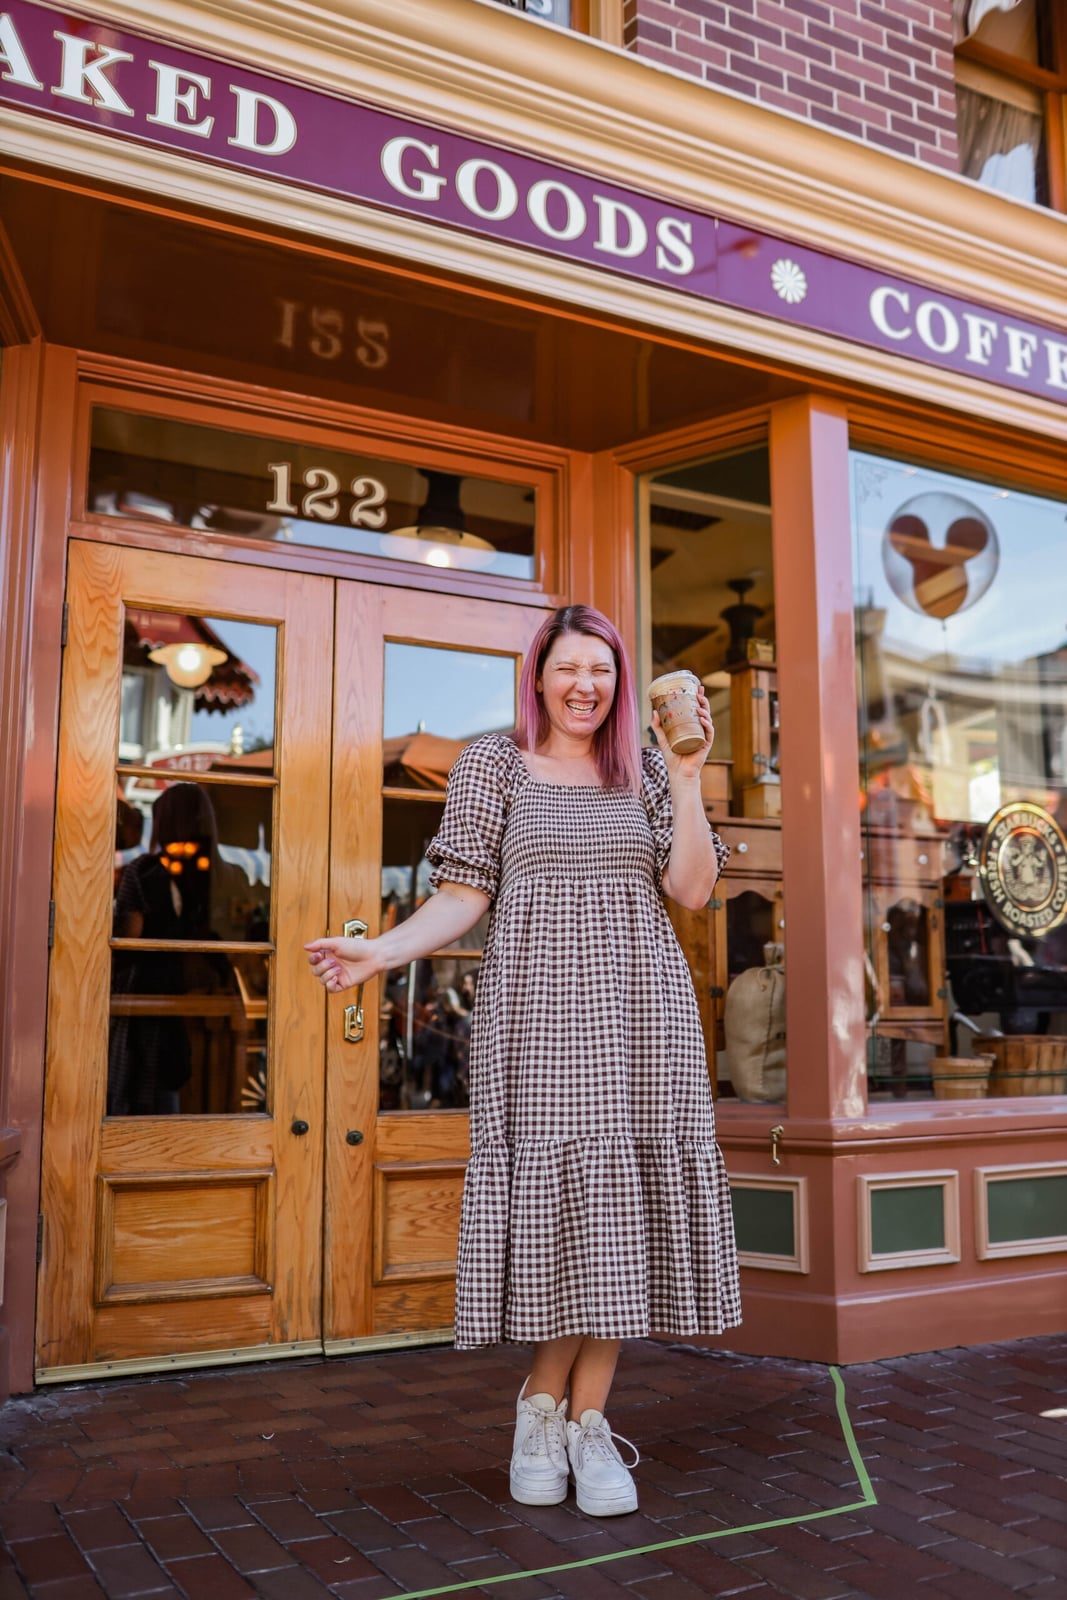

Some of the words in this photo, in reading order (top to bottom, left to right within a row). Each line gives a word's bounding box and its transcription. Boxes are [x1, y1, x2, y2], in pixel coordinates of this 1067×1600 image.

[380, 136, 695, 275] GOODS
[266, 462, 388, 529] 122
[987, 851, 1006, 903] FRESH
[1002, 901, 1053, 927] ROASTED
